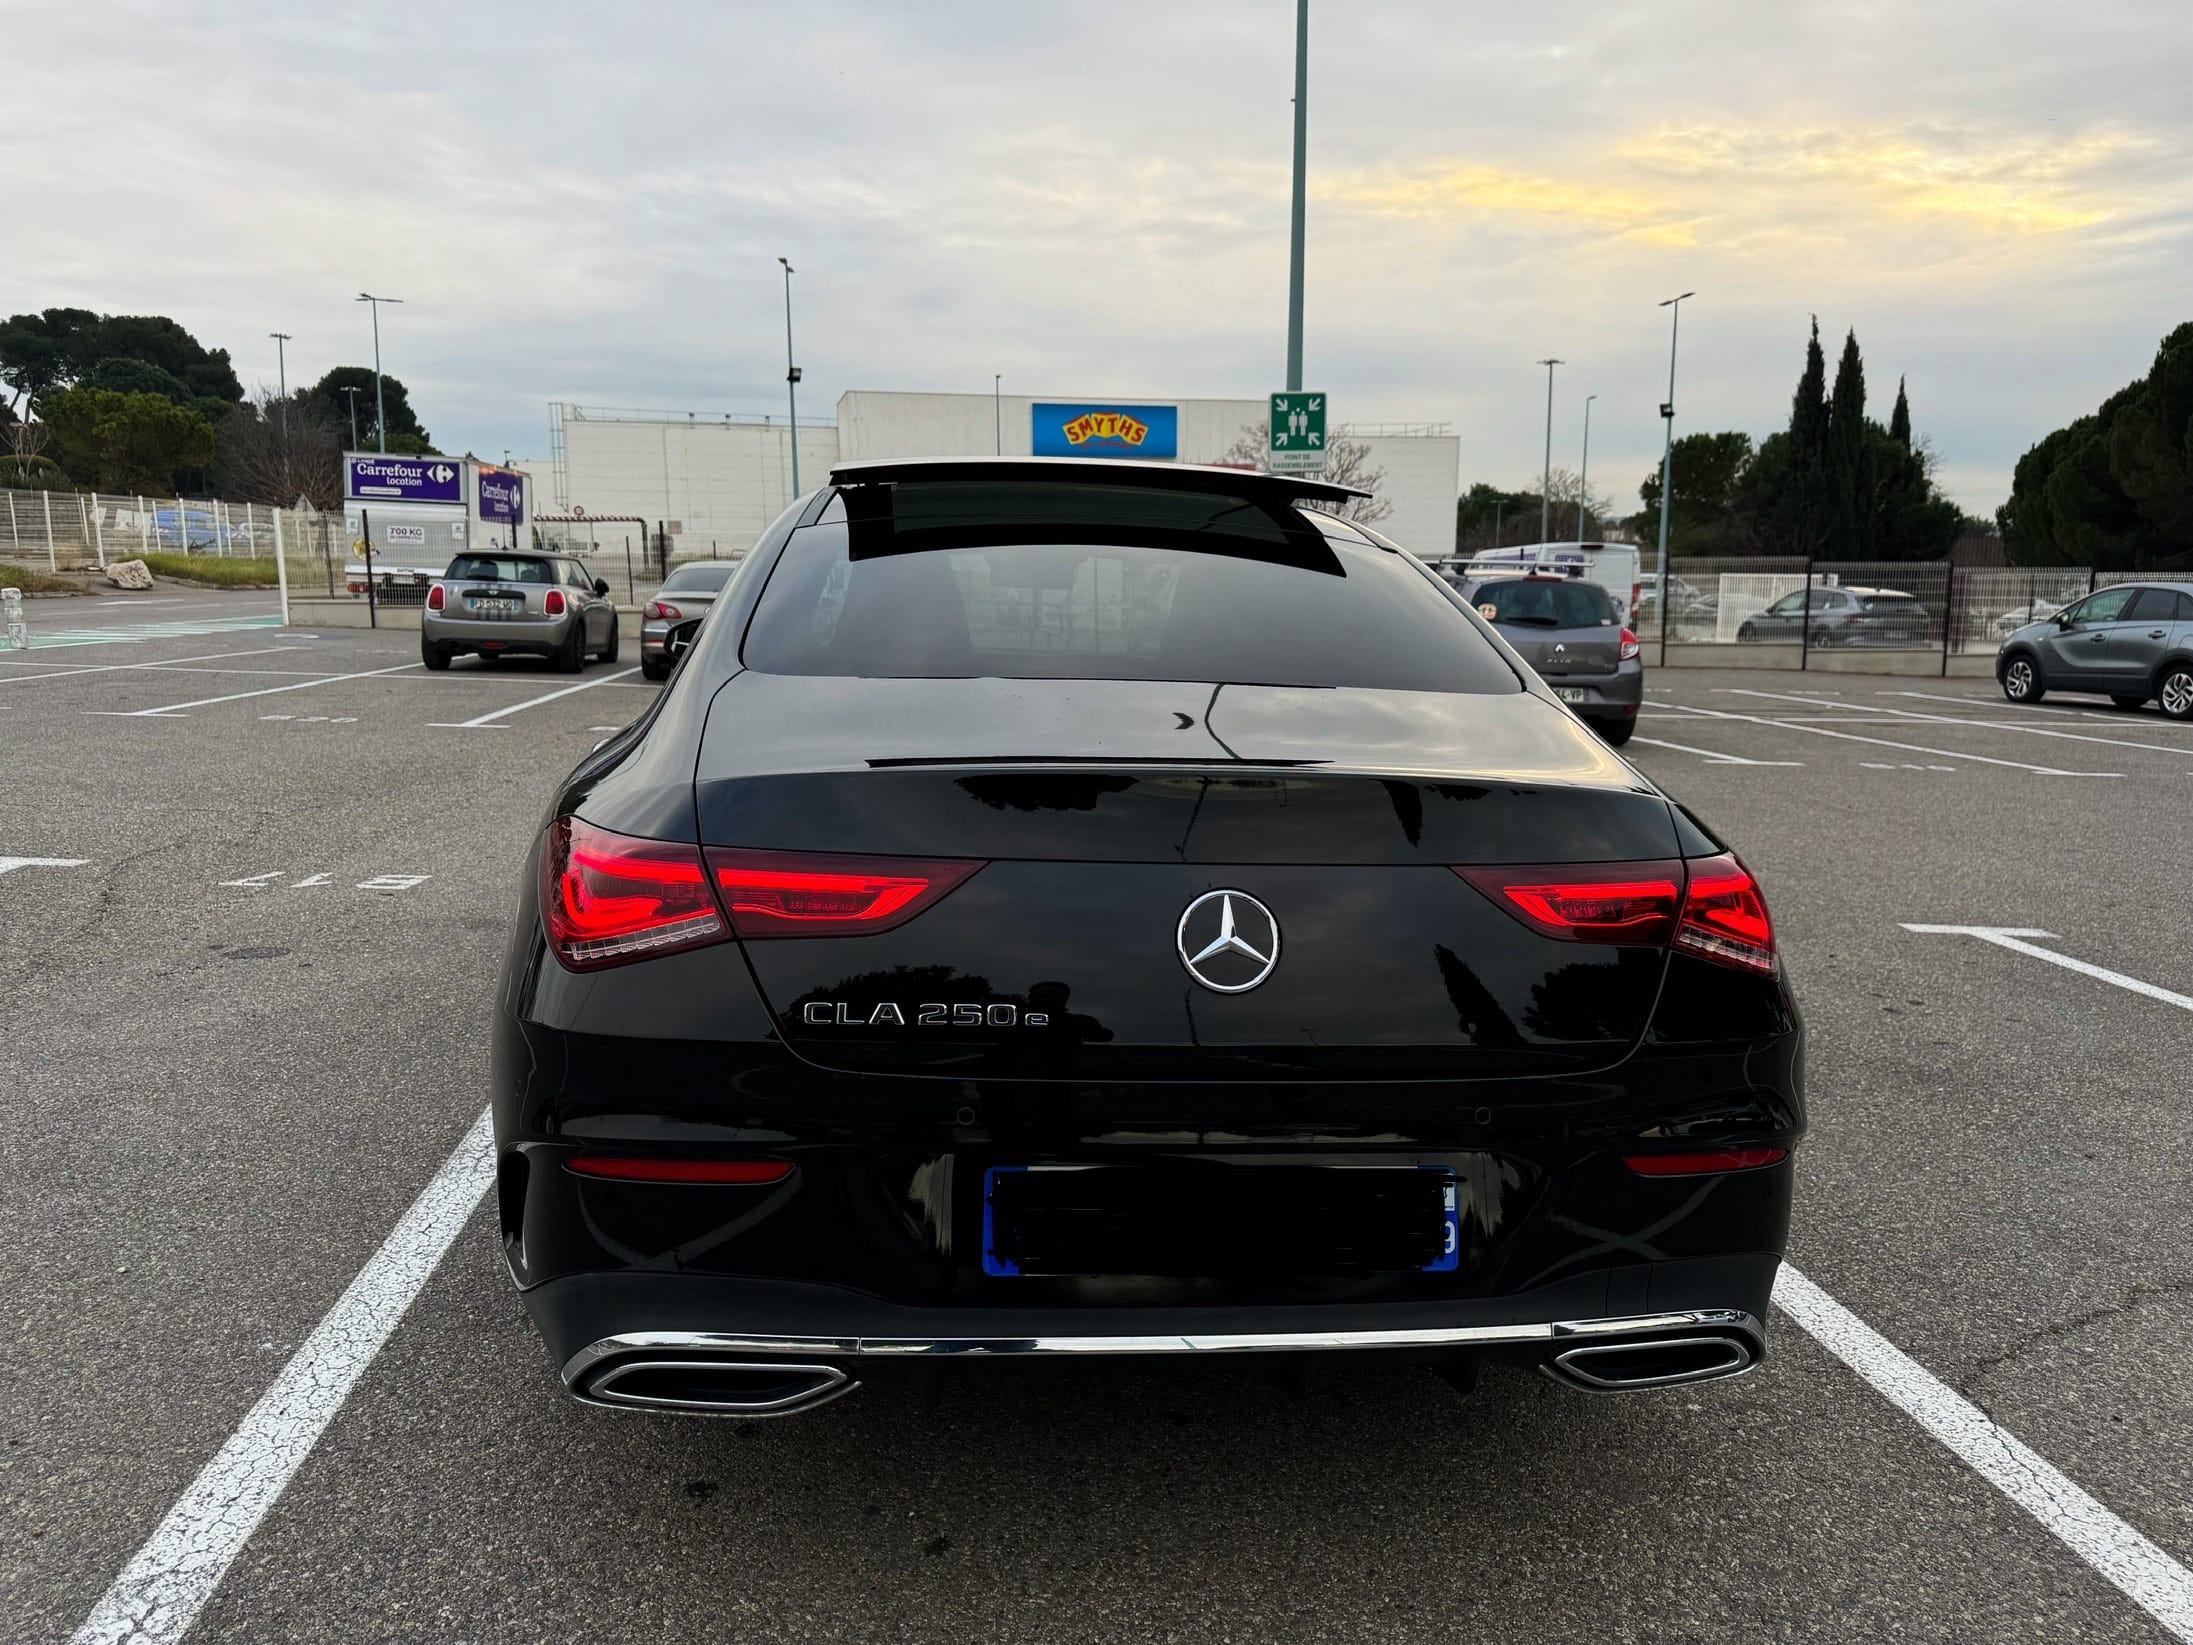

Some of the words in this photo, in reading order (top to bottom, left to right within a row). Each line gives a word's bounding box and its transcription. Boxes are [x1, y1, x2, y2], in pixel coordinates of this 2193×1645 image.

[1066, 416, 1145, 443] SMYTHS
[357, 463, 422, 477] Carrefour
[386, 477, 422, 486] location
[804, 1002, 905, 1025] CLA
[918, 1003, 1017, 1026] 250
